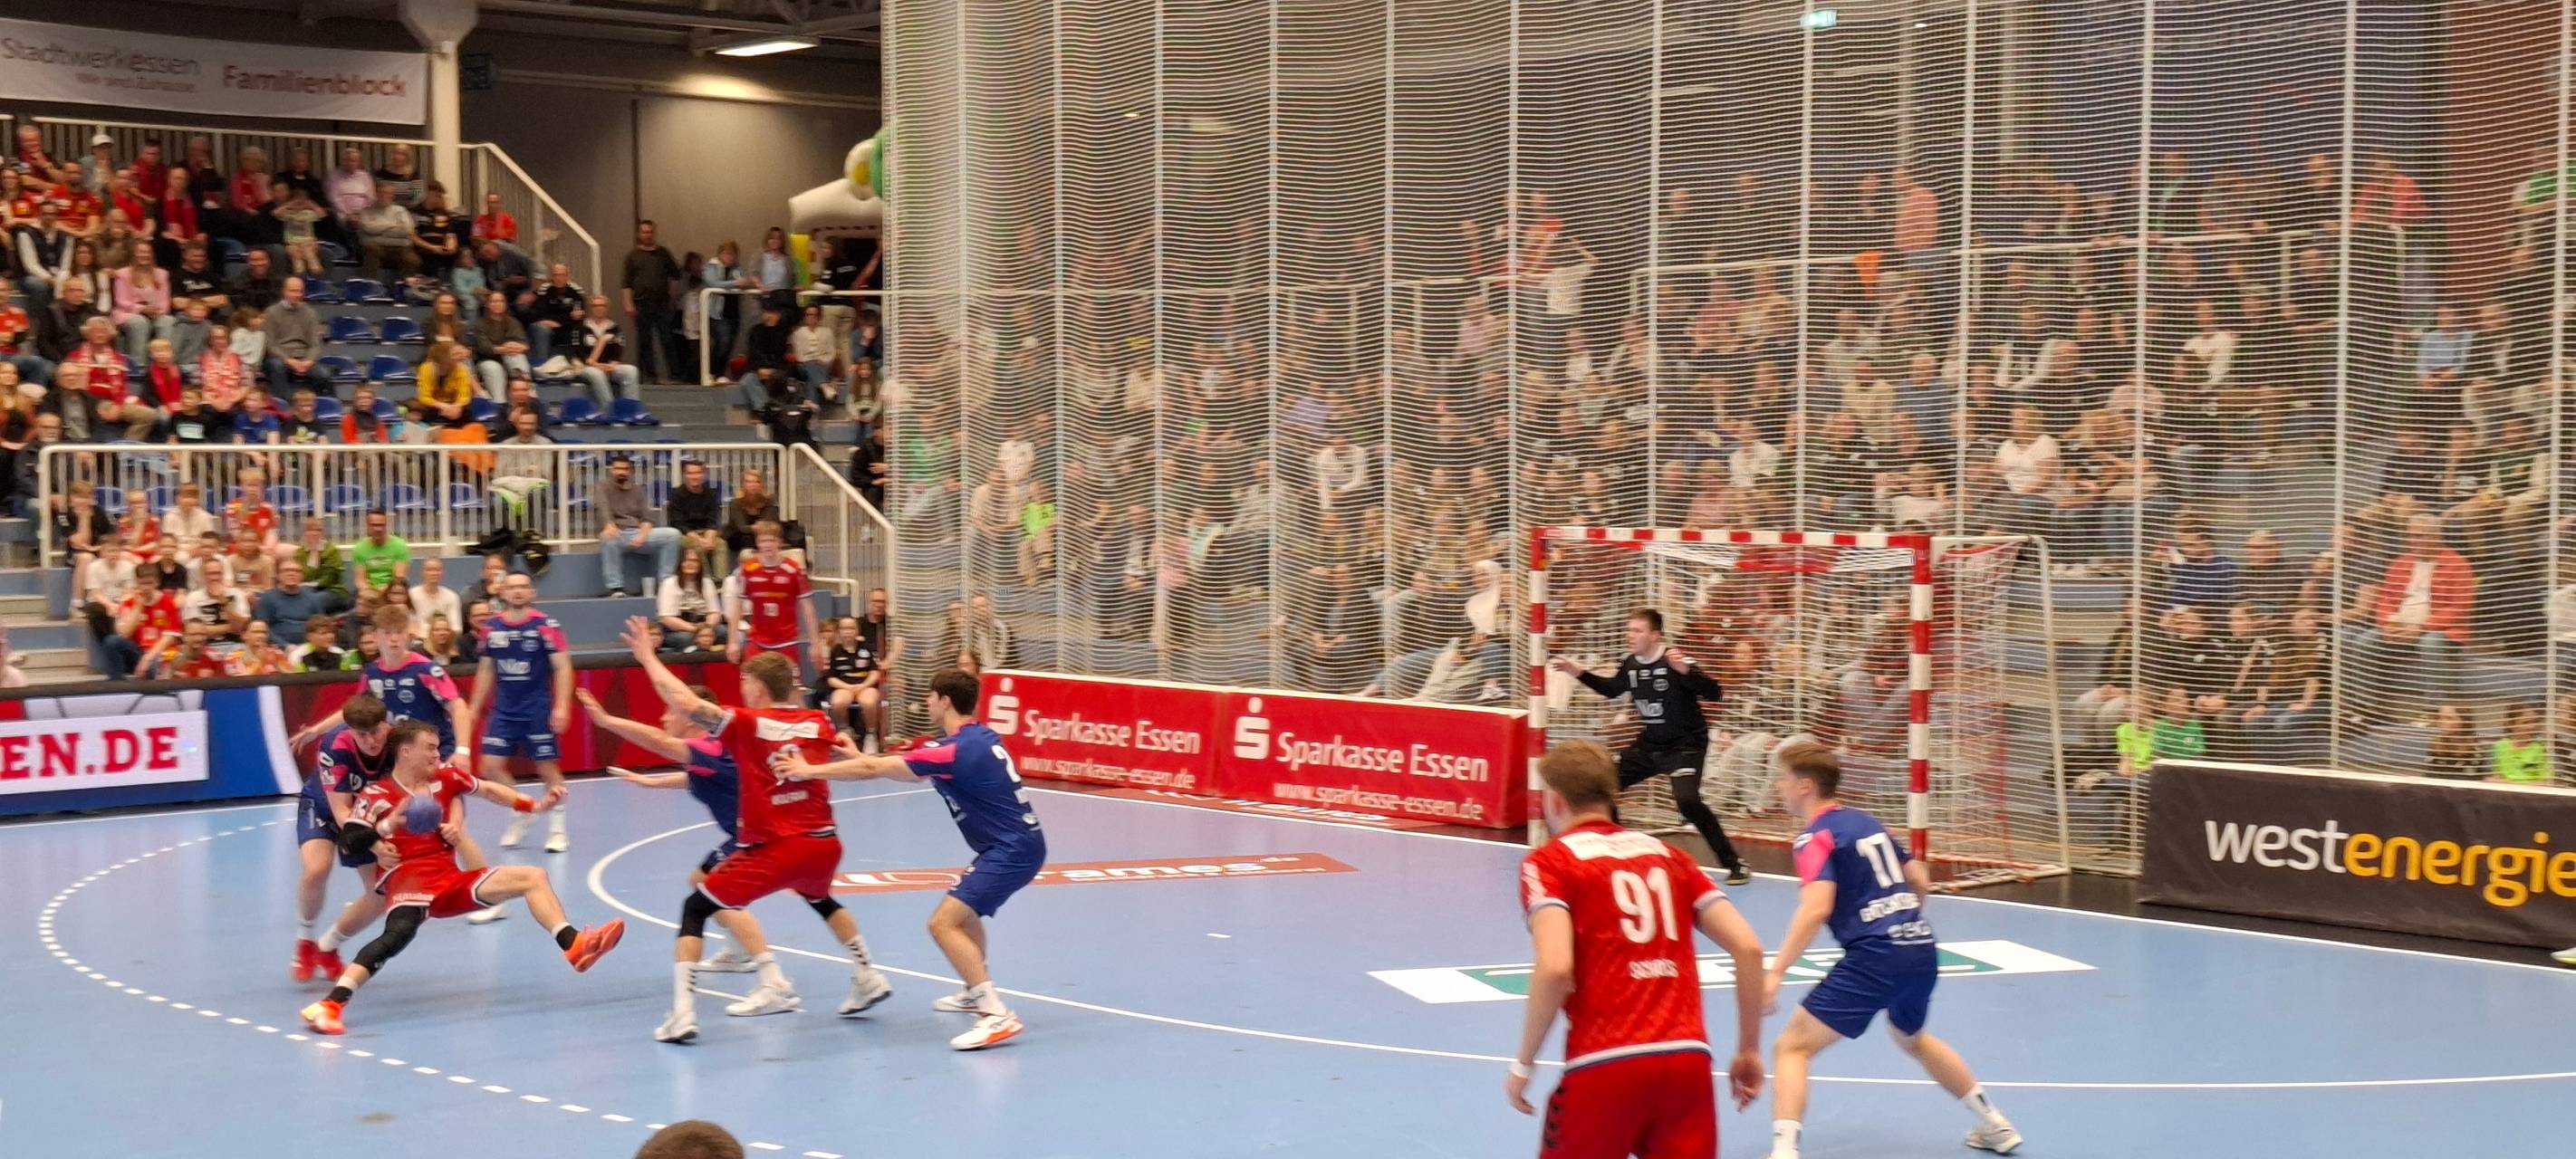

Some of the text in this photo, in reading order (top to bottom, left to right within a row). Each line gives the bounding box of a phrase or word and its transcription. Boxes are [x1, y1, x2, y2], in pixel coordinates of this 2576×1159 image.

[0, 726, 178, 781] EN.DE
[1023, 710, 1131, 746] Sparkasse
[1135, 720, 1201, 754] Essen
[1275, 732, 1405, 771] Sparkasse
[1409, 743, 1488, 782] Essen
[1274, 781, 1485, 820] www.sparkasse-essen.de
[2205, 819, 2576, 907] westenergie
[1611, 867, 1679, 943] 91
